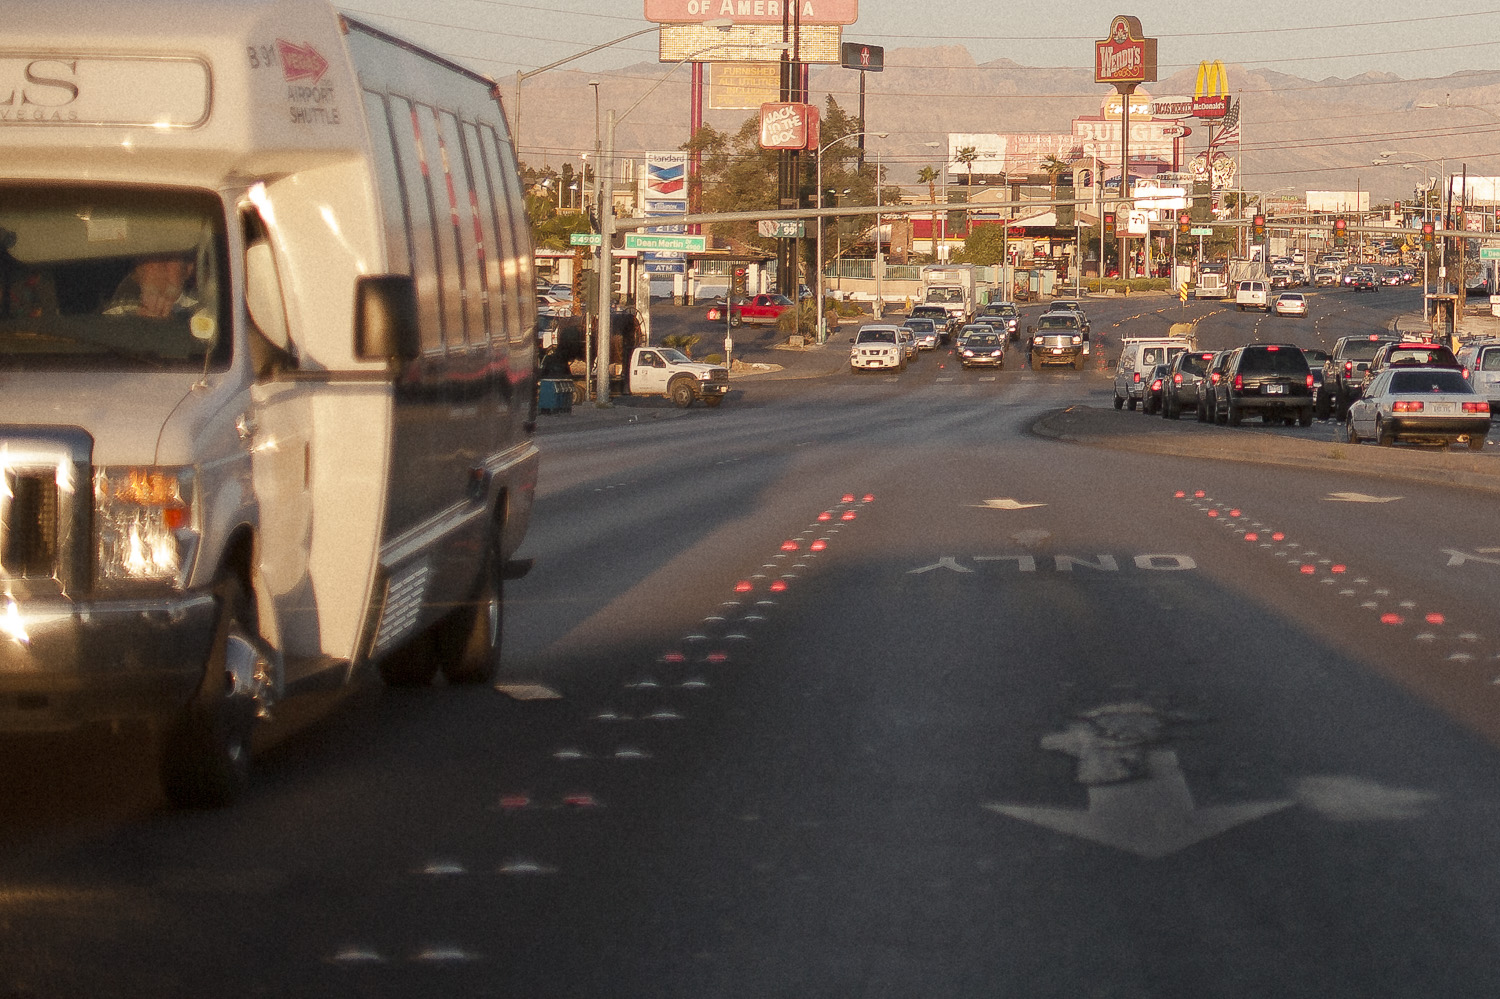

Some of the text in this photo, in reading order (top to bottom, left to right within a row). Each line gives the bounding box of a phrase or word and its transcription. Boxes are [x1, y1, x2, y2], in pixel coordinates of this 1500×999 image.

[687, 0, 711, 15] OF
[724, 67, 776, 75] FURNISHED
[287, 85, 335, 103] AIRPORT
[1193, 102, 1225, 110] McDonald's
[0, 109, 79, 121] VEGAS
[289, 106, 340, 124] SHUTTLE
[766, 105, 795, 124] JACK
[636, 239, 657, 247] Dean
[658, 240, 684, 248] Martin
[905, 554, 1198, 574] ONLY
